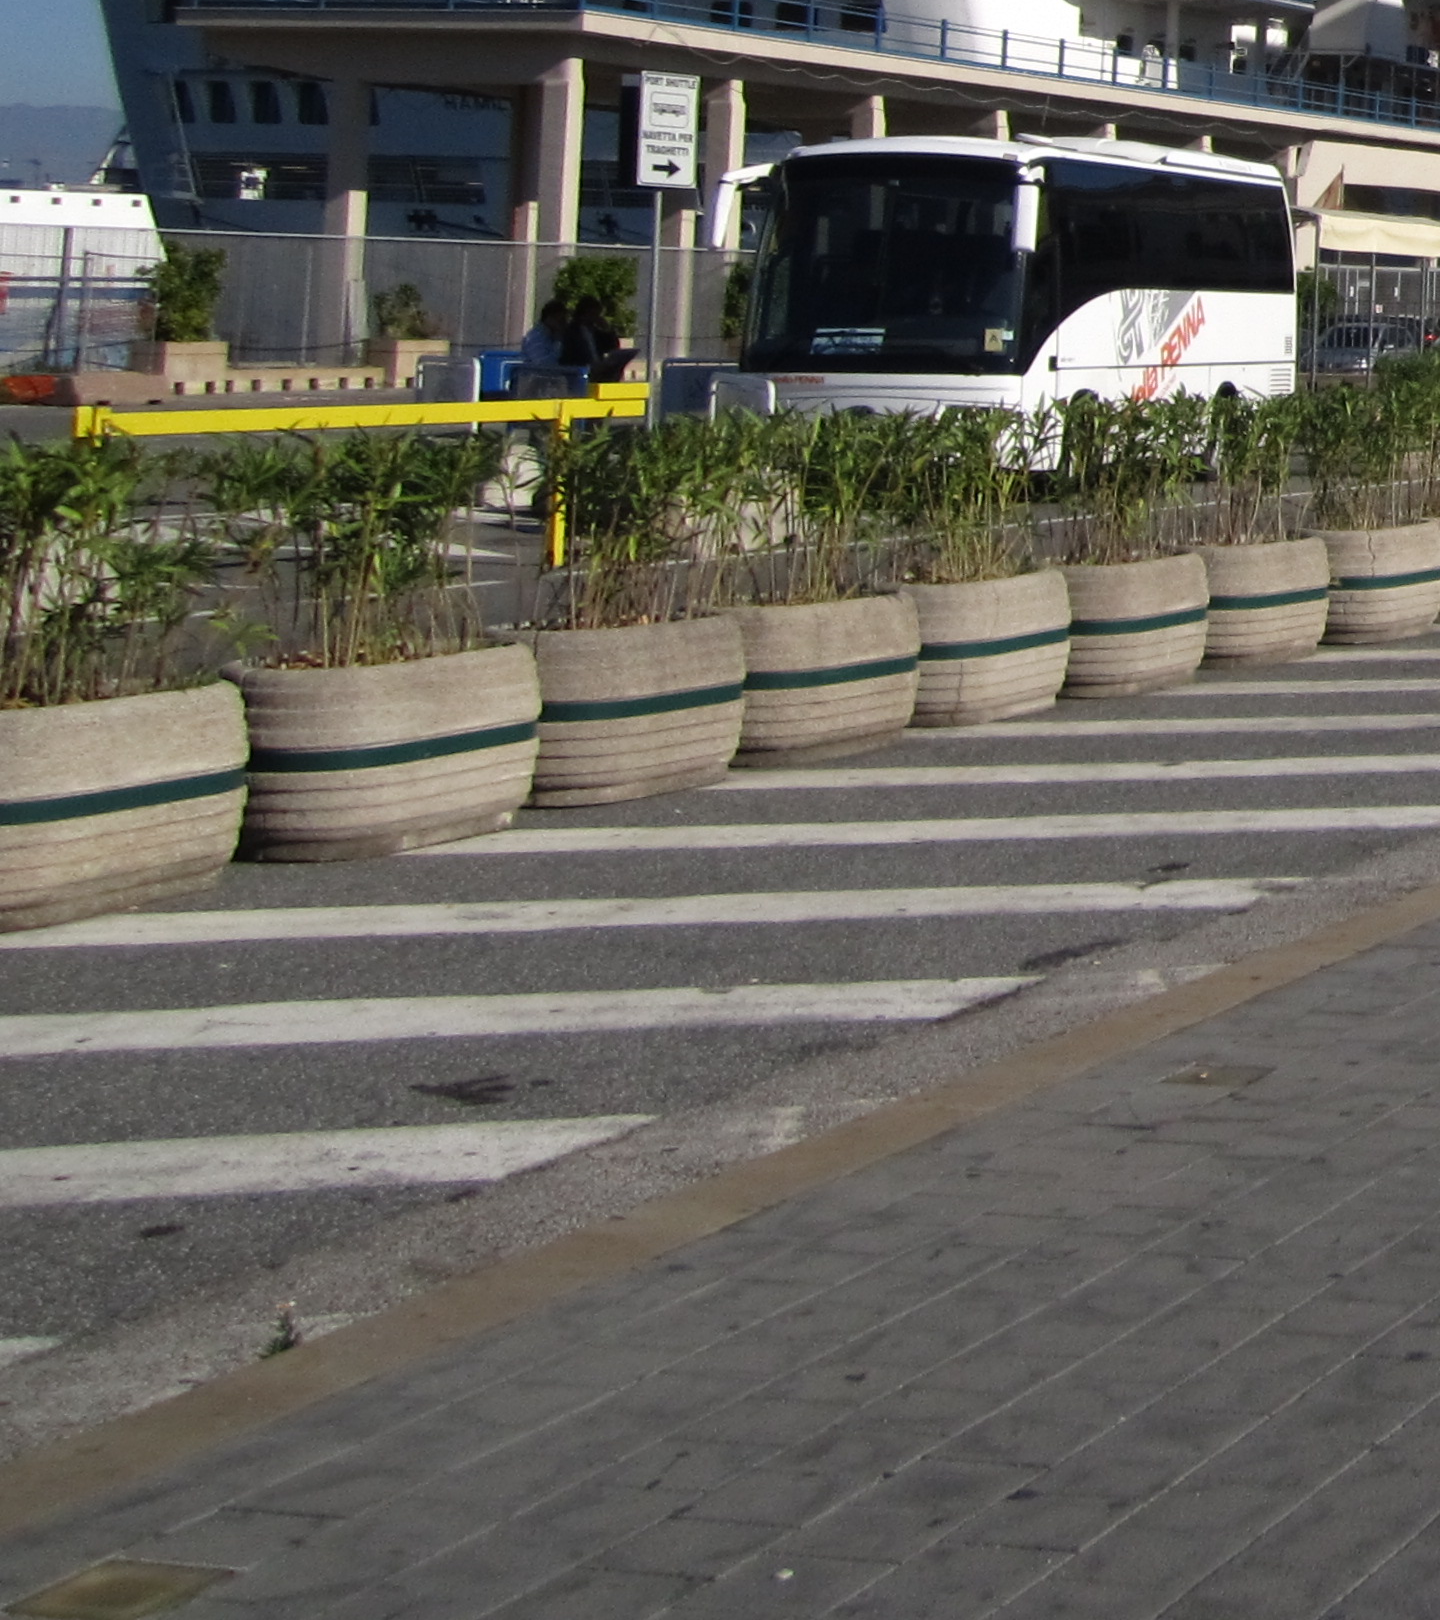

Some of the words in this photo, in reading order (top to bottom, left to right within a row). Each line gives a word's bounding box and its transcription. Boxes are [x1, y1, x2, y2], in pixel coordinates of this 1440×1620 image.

[645, 76, 664, 86] PORT
[665, 78, 696, 89] SHUTTLE
[643, 131, 676, 141] NAVETTA
[678, 133, 693, 143] PER
[1160, 295, 1206, 381] PENNA
